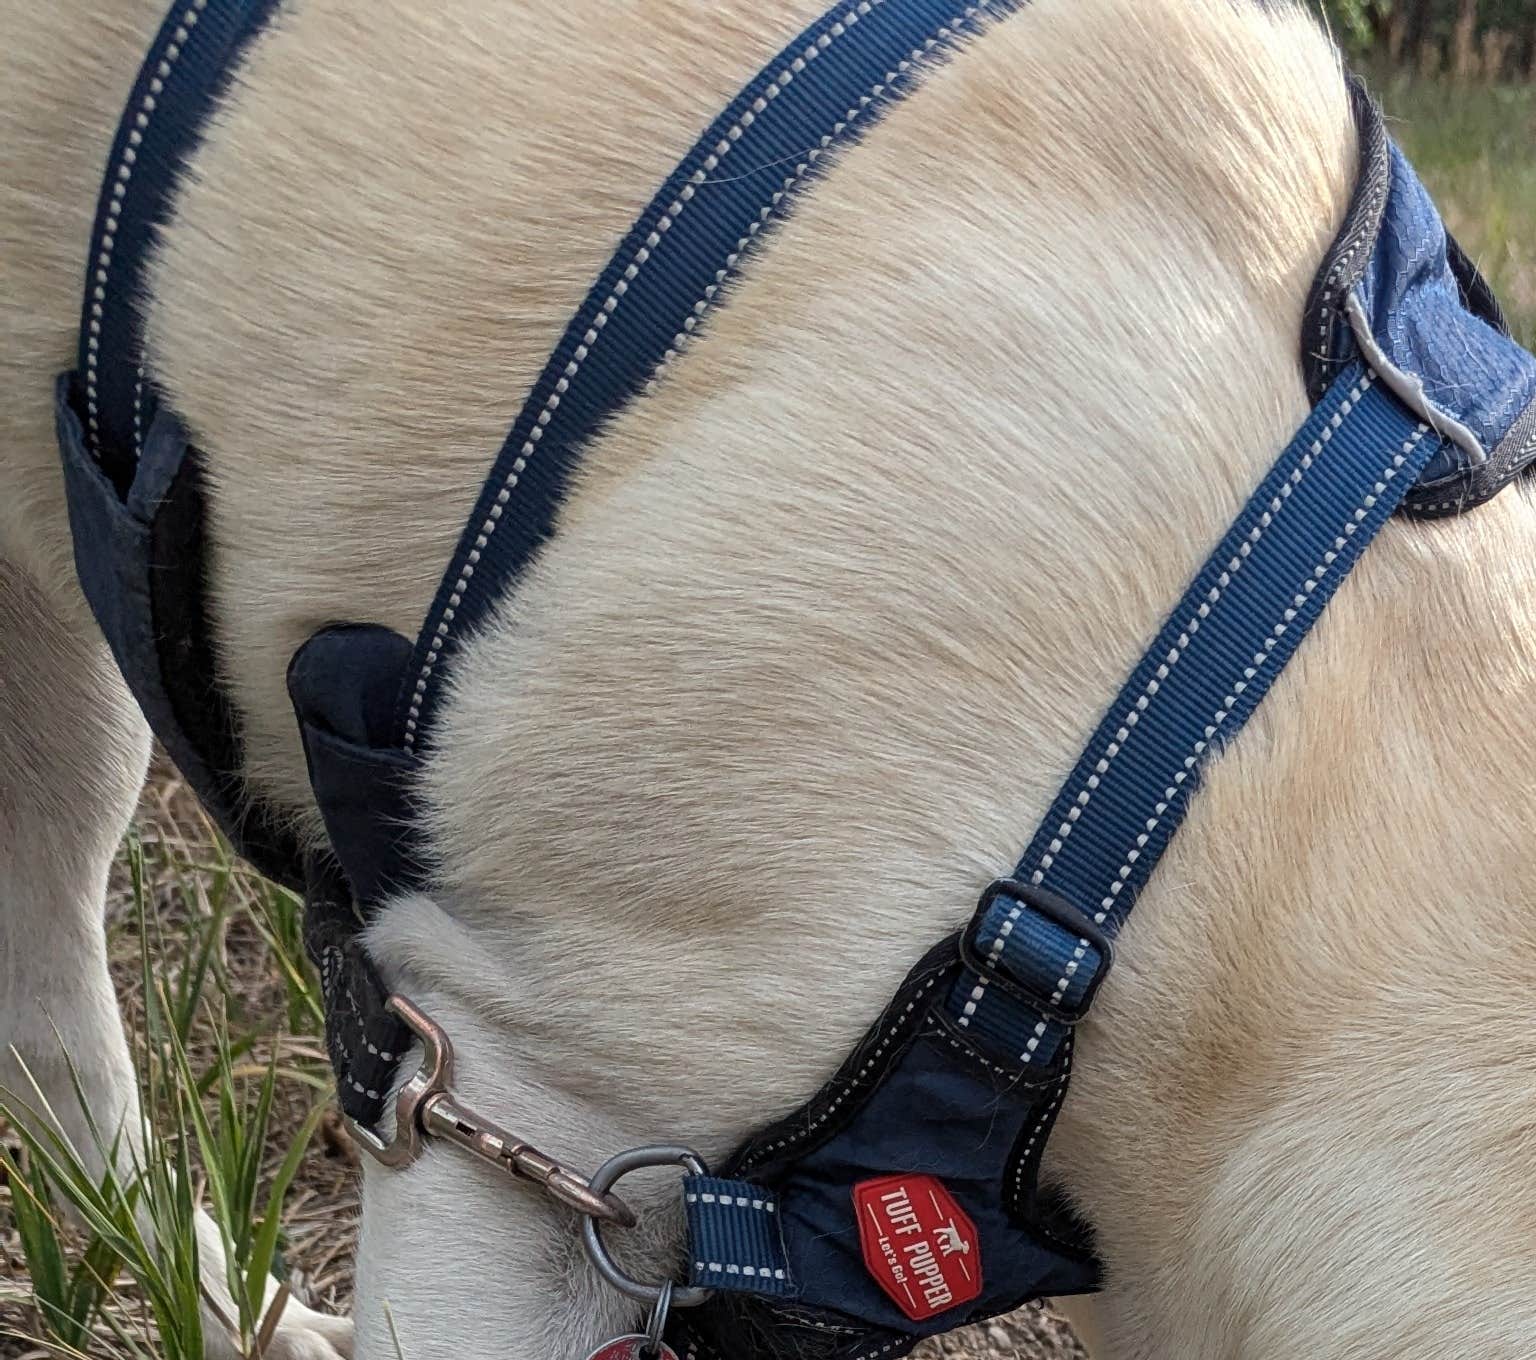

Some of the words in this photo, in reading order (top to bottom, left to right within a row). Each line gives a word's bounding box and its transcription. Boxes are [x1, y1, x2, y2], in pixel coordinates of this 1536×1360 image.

[878, 1236, 897, 1266] Let's
[891, 1264, 908, 1284] Go!
[881, 1186, 922, 1235] TUFF
[903, 1240, 953, 1309] PUPPER
